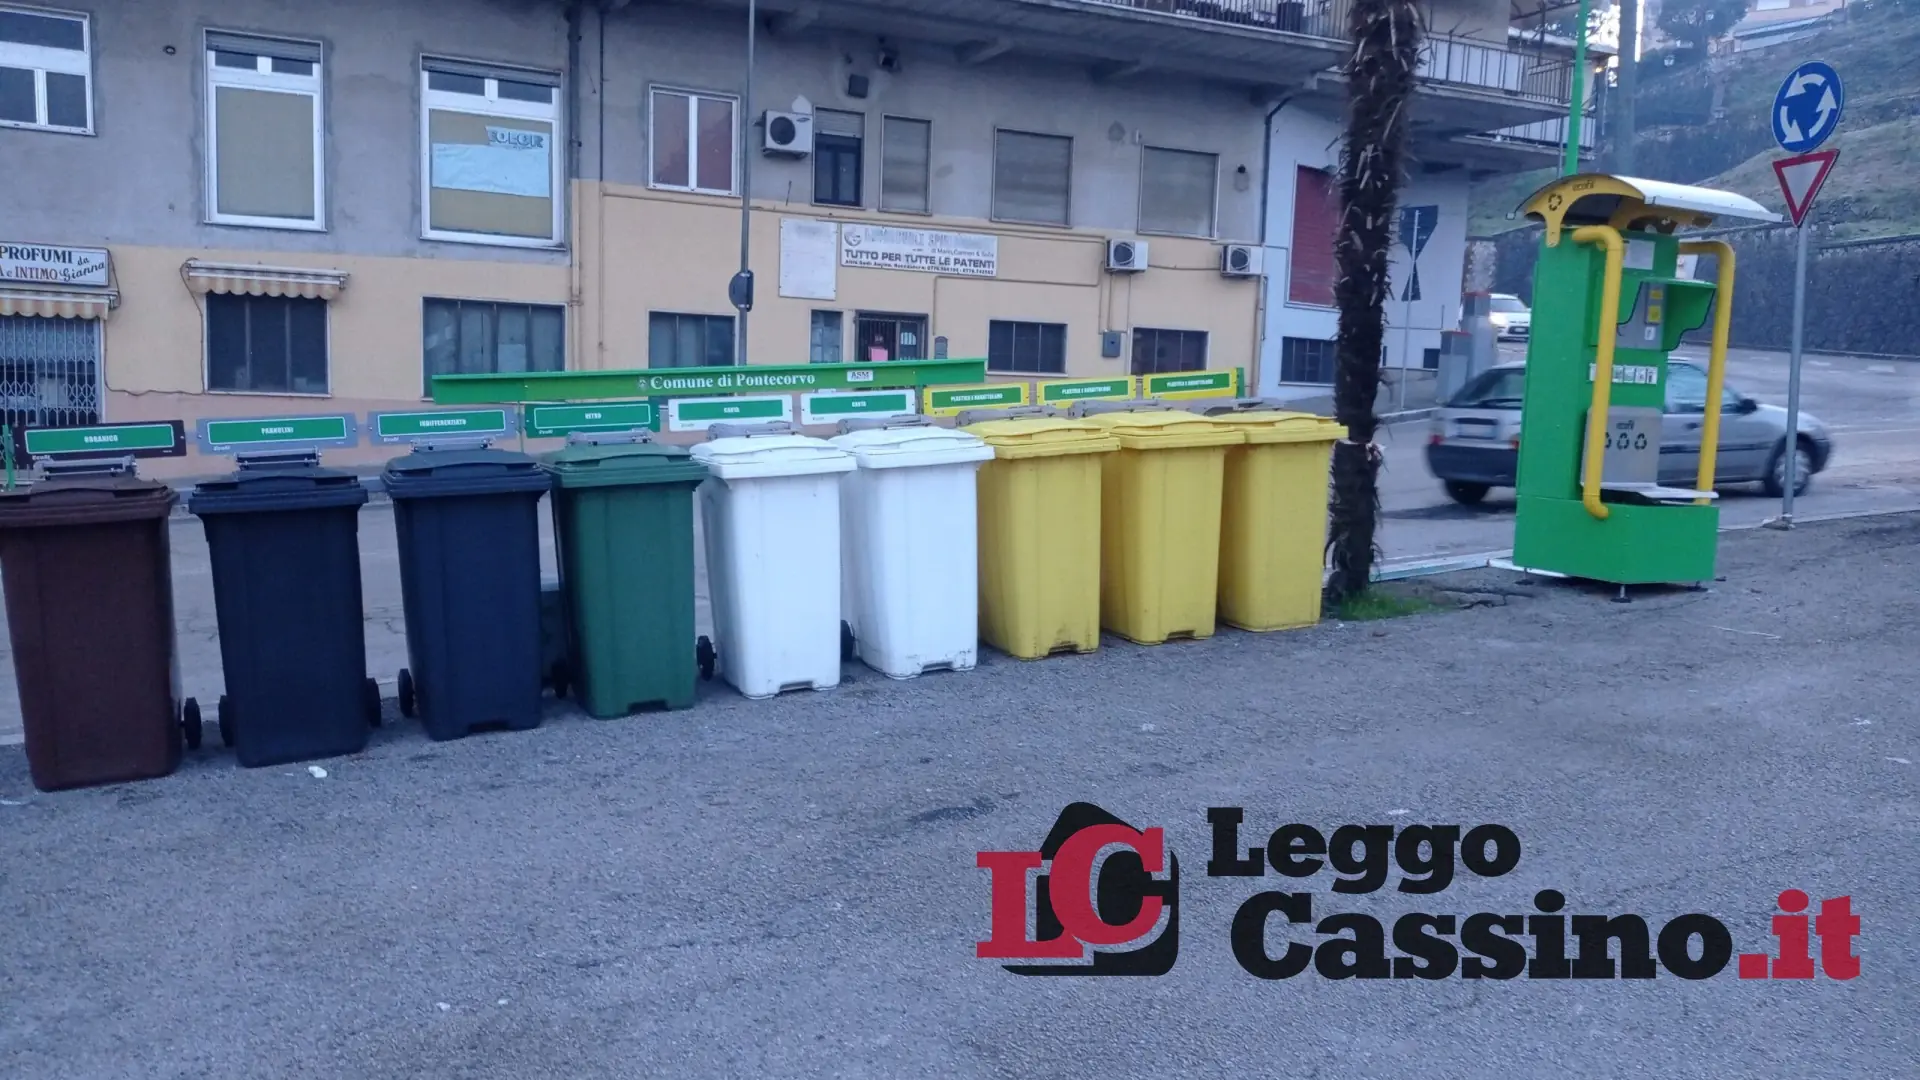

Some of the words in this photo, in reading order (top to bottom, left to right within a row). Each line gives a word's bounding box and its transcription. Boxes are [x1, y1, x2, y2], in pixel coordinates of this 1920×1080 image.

[0, 245, 73, 264] PROFUMI
[844, 249, 878, 260] TUTTO
[882, 253, 901, 262] PER
[905, 254, 936, 266] TUTTE
[939, 257, 950, 266] LE
[953, 258, 994, 269] PATENTI
[15, 265, 58, 280] INTIMO
[59, 261, 105, 282] Gianna
[650, 375, 713, 390] Comune
[718, 374, 732, 388] di
[736, 373, 816, 388] Pontecorvo
